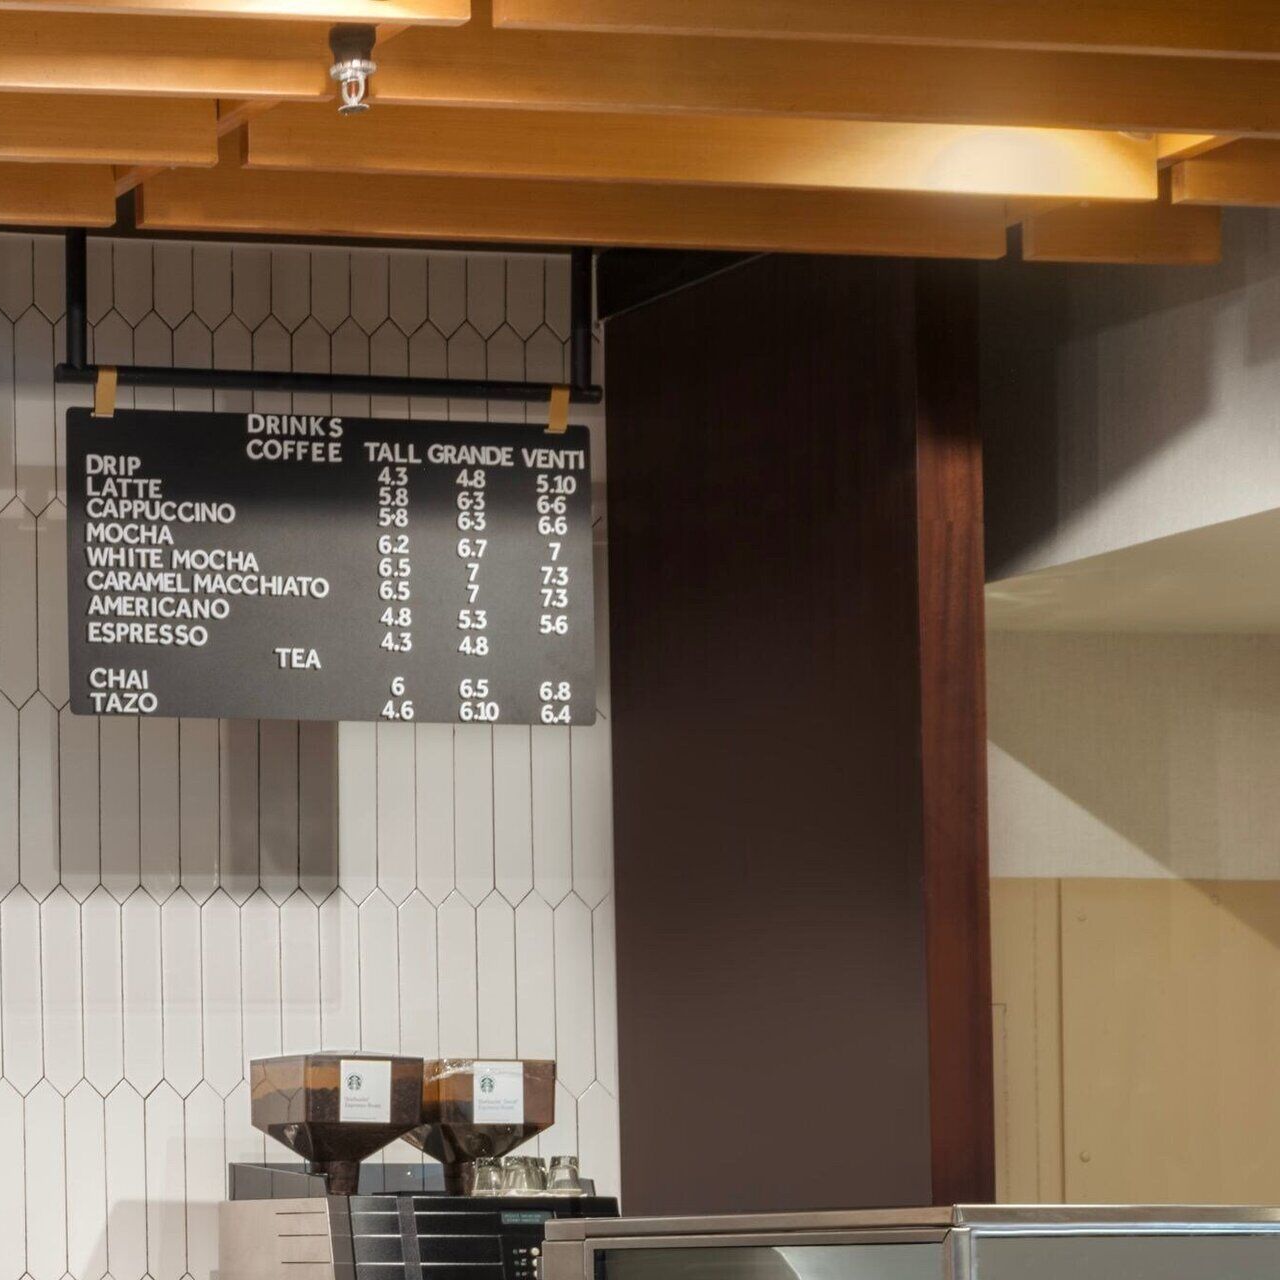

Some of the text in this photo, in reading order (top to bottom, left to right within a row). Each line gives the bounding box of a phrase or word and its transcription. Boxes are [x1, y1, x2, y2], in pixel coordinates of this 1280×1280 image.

[247, 413, 344, 438] DRINKS
[246, 439, 585, 470] COFFEE TALL GRANDE VENTI
[86, 454, 577, 495] DRIP 4.3 4.8 5.10
[86, 476, 567, 515] LATTE 5.8 6.3 6.6
[86, 498, 236, 524] CAPPUCCINO
[457, 511, 486, 531] 6.3
[537, 516, 568, 536] 6.6
[86, 522, 561, 561] MOCHA 6.2 6.7 7
[86, 547, 569, 586] WHITE MOCHA 6.5 7 7.3
[86, 570, 569, 608] CARAMEL MACCHIATO 6.5 7 7.3
[87, 594, 569, 634] AMERICANO 4.8 5.3 5.6
[87, 621, 489, 656] ESPRESSO 4.3 4.8
[276, 648, 322, 669] TEA
[90, 667, 571, 701] CHAI 6 6.5 6.8
[90, 692, 571, 724] TAZO 4.6 6.10 6.4
